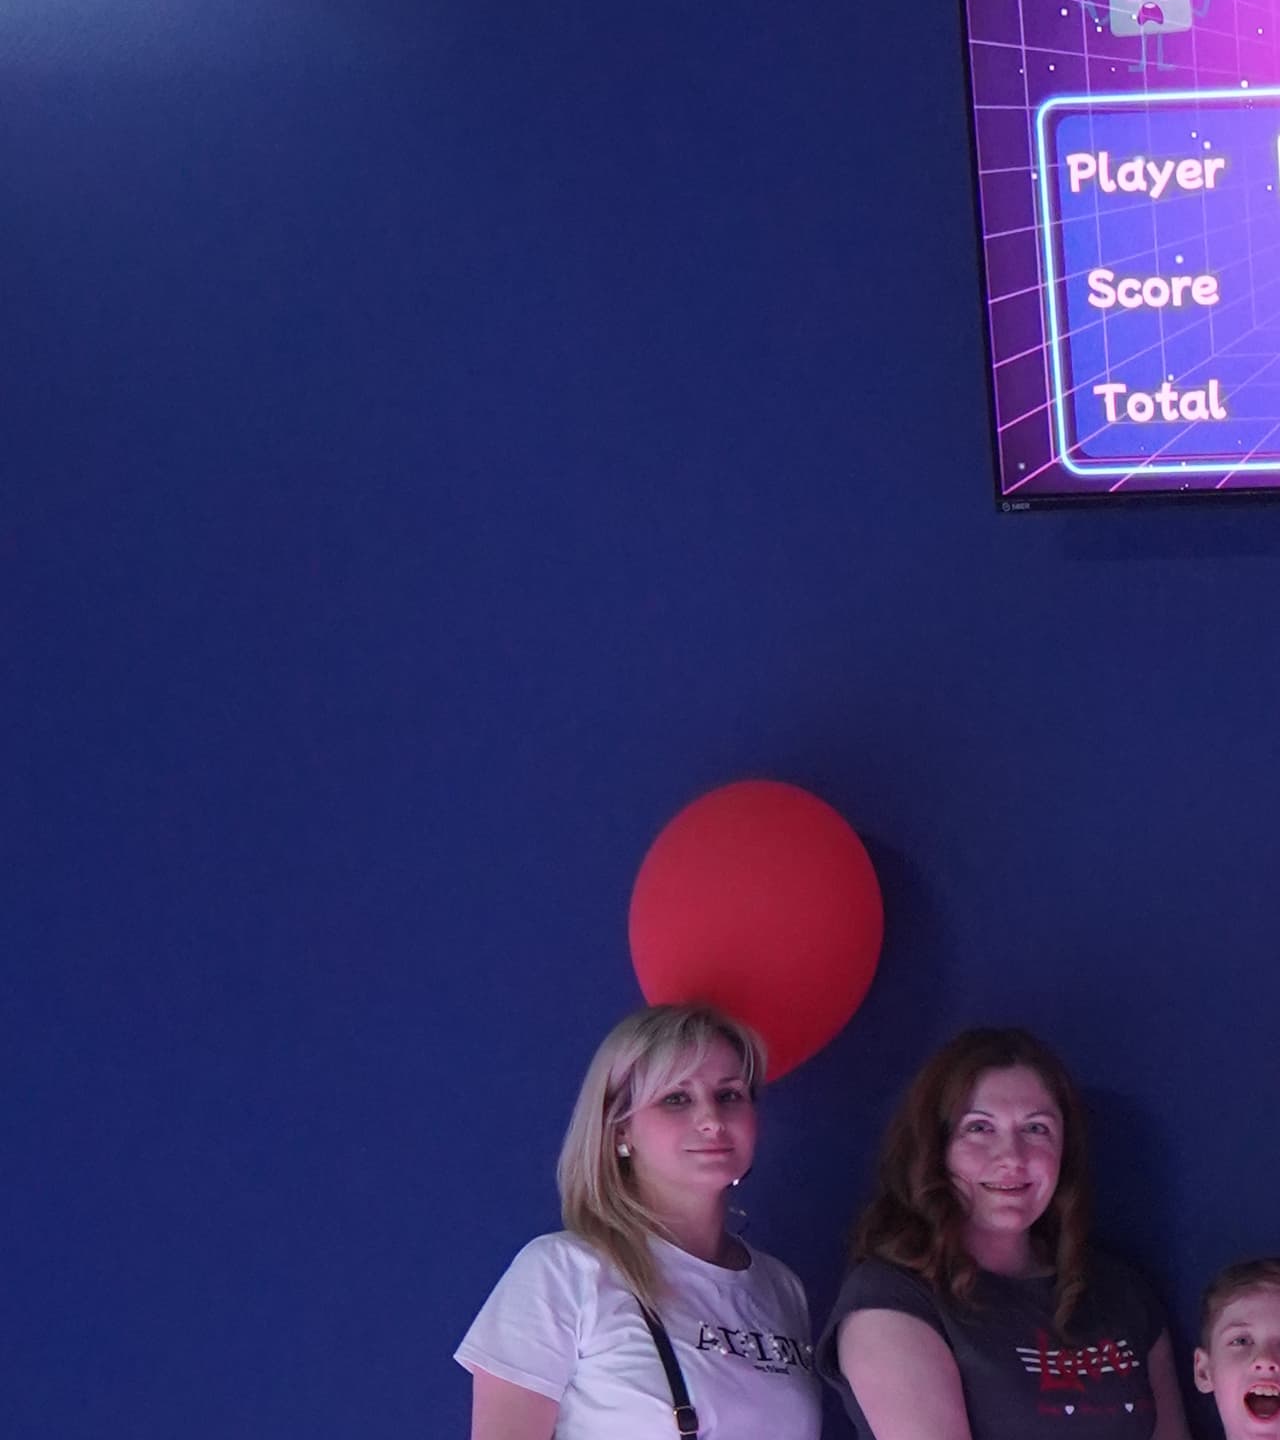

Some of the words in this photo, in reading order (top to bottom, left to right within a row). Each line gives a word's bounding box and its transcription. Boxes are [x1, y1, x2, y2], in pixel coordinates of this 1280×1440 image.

[1066, 151, 1225, 199] Player
[1087, 268, 1220, 309] Score
[1093, 379, 1227, 423] Total
